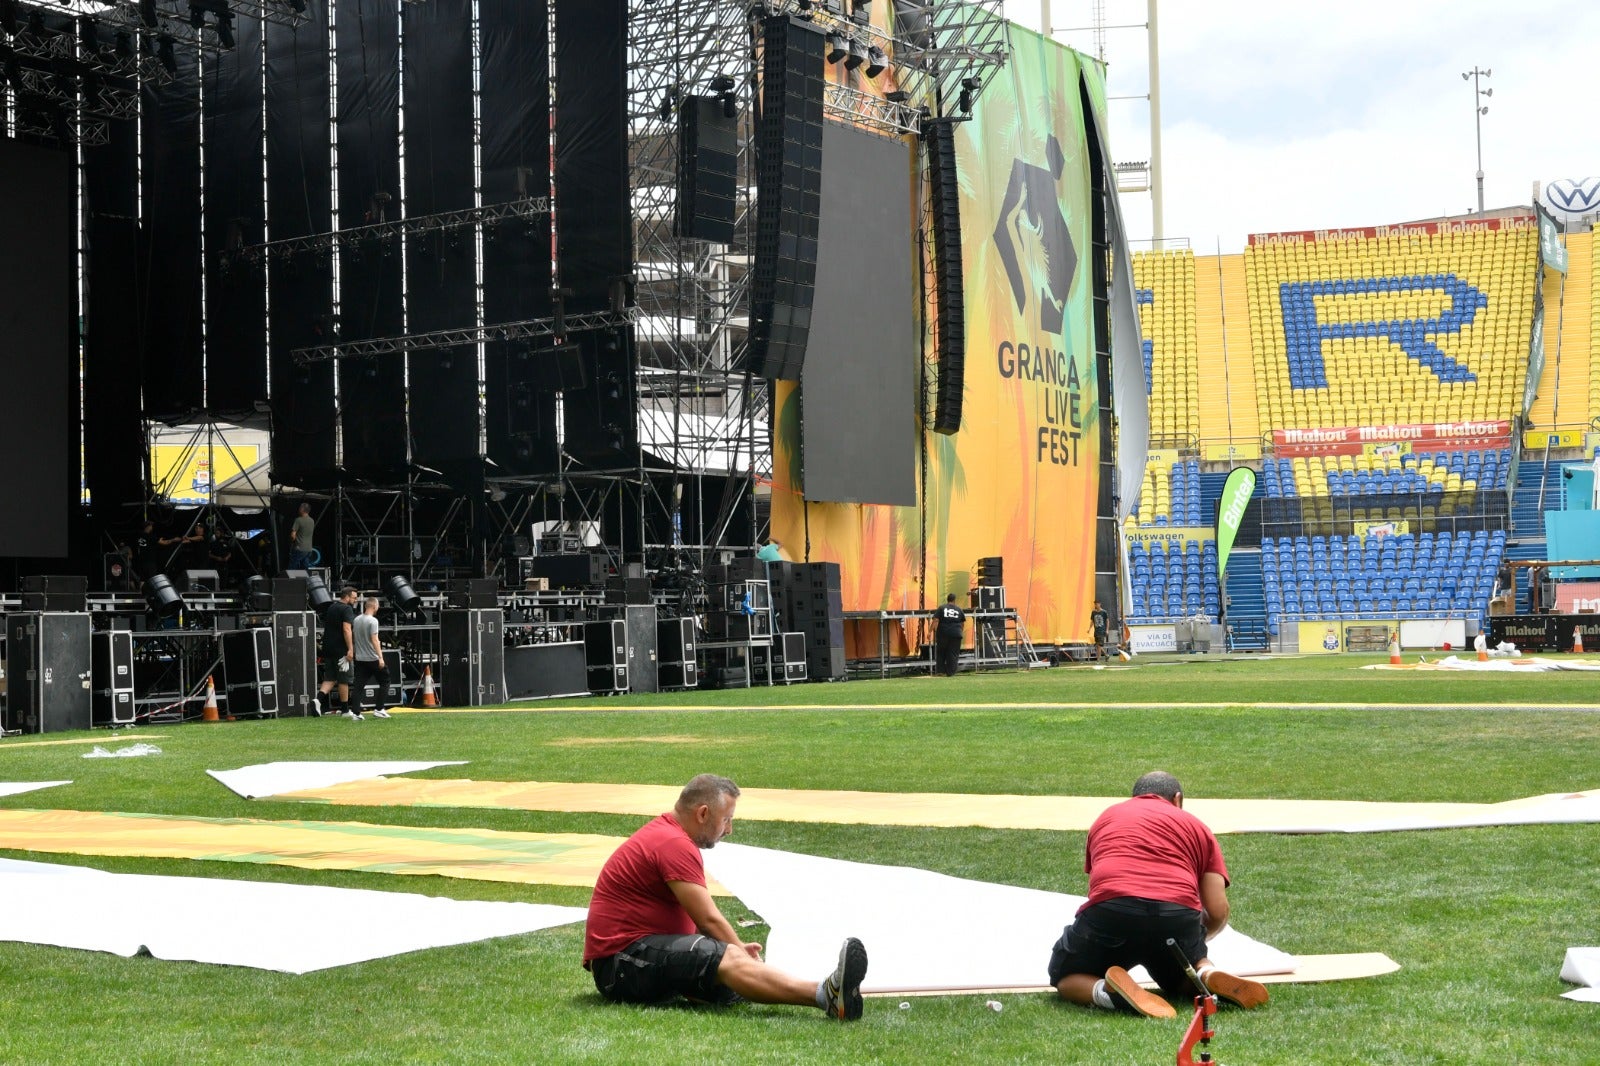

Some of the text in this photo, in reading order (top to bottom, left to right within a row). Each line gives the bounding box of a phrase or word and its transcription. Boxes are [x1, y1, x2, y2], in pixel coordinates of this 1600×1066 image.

[1254, 232, 1304, 244] Mahou
[1314, 229, 1365, 241] Mahou
[1375, 224, 1427, 238] Mahou
[1437, 219, 1489, 234] Mahou
[998, 340, 1080, 390] GRANCA
[1045, 387, 1081, 428] LIVE
[1038, 426, 1081, 466] FEST
[1285, 421, 1499, 443] Mahou Mahou Mahou
[1223, 474, 1255, 530] Binter
[1505, 625, 1546, 636] Mahou
